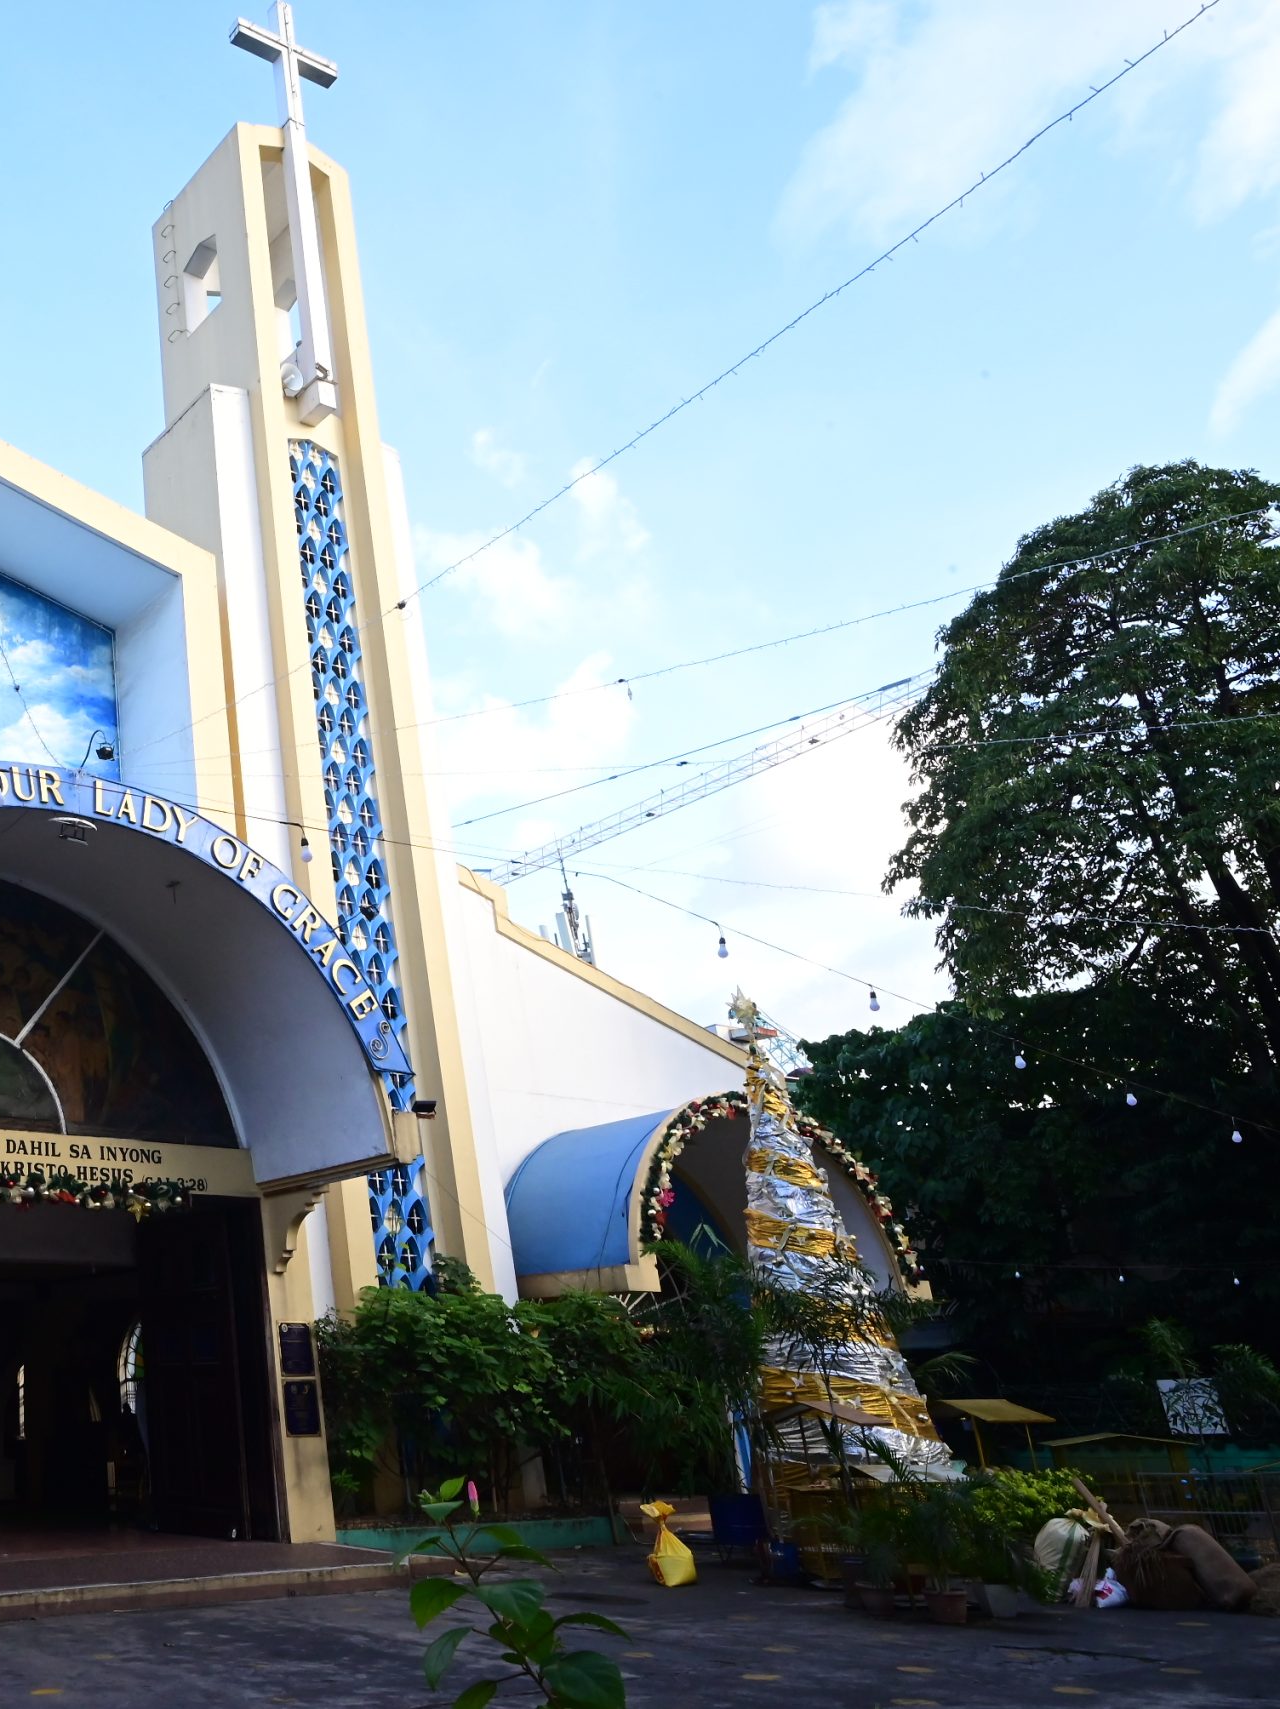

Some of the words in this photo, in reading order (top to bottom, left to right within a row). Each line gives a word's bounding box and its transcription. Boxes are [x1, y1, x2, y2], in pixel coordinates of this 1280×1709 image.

[92, 780, 199, 844] LADY
[211, 836, 264, 882] OF
[270, 884, 379, 1021] GRACE
[6, 1139, 61, 1158] DAHIL
[69, 1144, 92, 1160] SA
[100, 1146, 162, 1165] INYONG
[0, 1161, 68, 1179] KRISTO
[77, 1165, 134, 1184] HESUS
